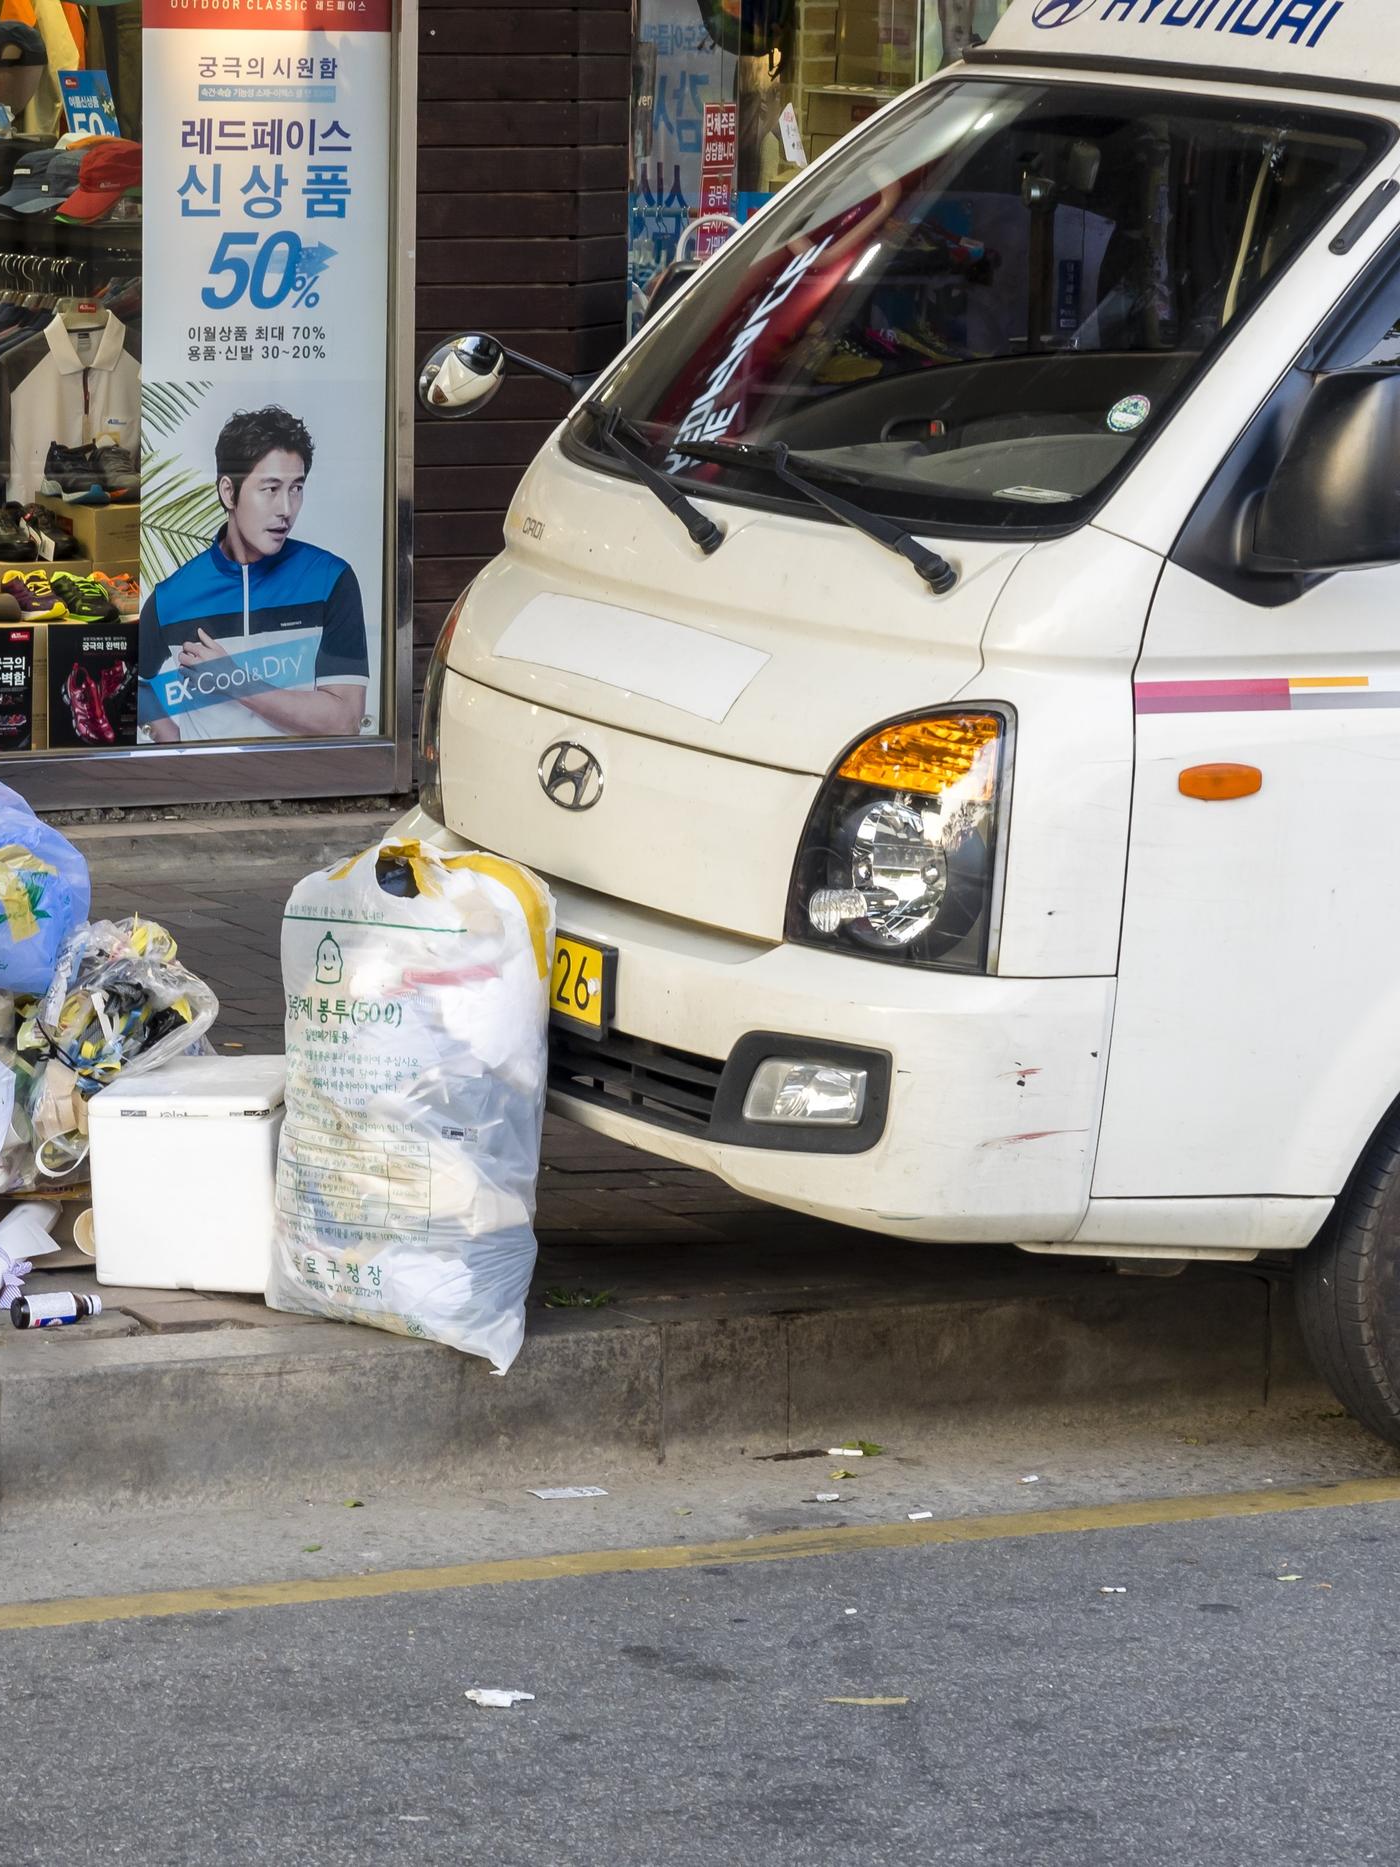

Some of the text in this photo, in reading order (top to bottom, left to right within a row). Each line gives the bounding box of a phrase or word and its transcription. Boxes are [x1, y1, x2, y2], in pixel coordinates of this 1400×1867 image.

[170, 0, 367, 11] OUTDOOR CLASSIC 레드페이스
[198, 57, 338, 80] 궁극의 시원함
[706, 112, 736, 137] 단체주문
[181, 118, 352, 156] 레드페이스
[705, 142, 735, 162] 상담합니다
[176, 163, 352, 219] 신상품
[708, 184, 729, 207] 공무원
[188, 325, 326, 342] 이월상품 최대 70%
[187, 345, 326, 361] 용품·신발 30~20%
[522, 516, 546, 541] CRDi
[82, 641, 104, 651] 궁극의
[165, 653, 303, 707] EX-Cool&Dry
[556, 948, 590, 1010] 26
